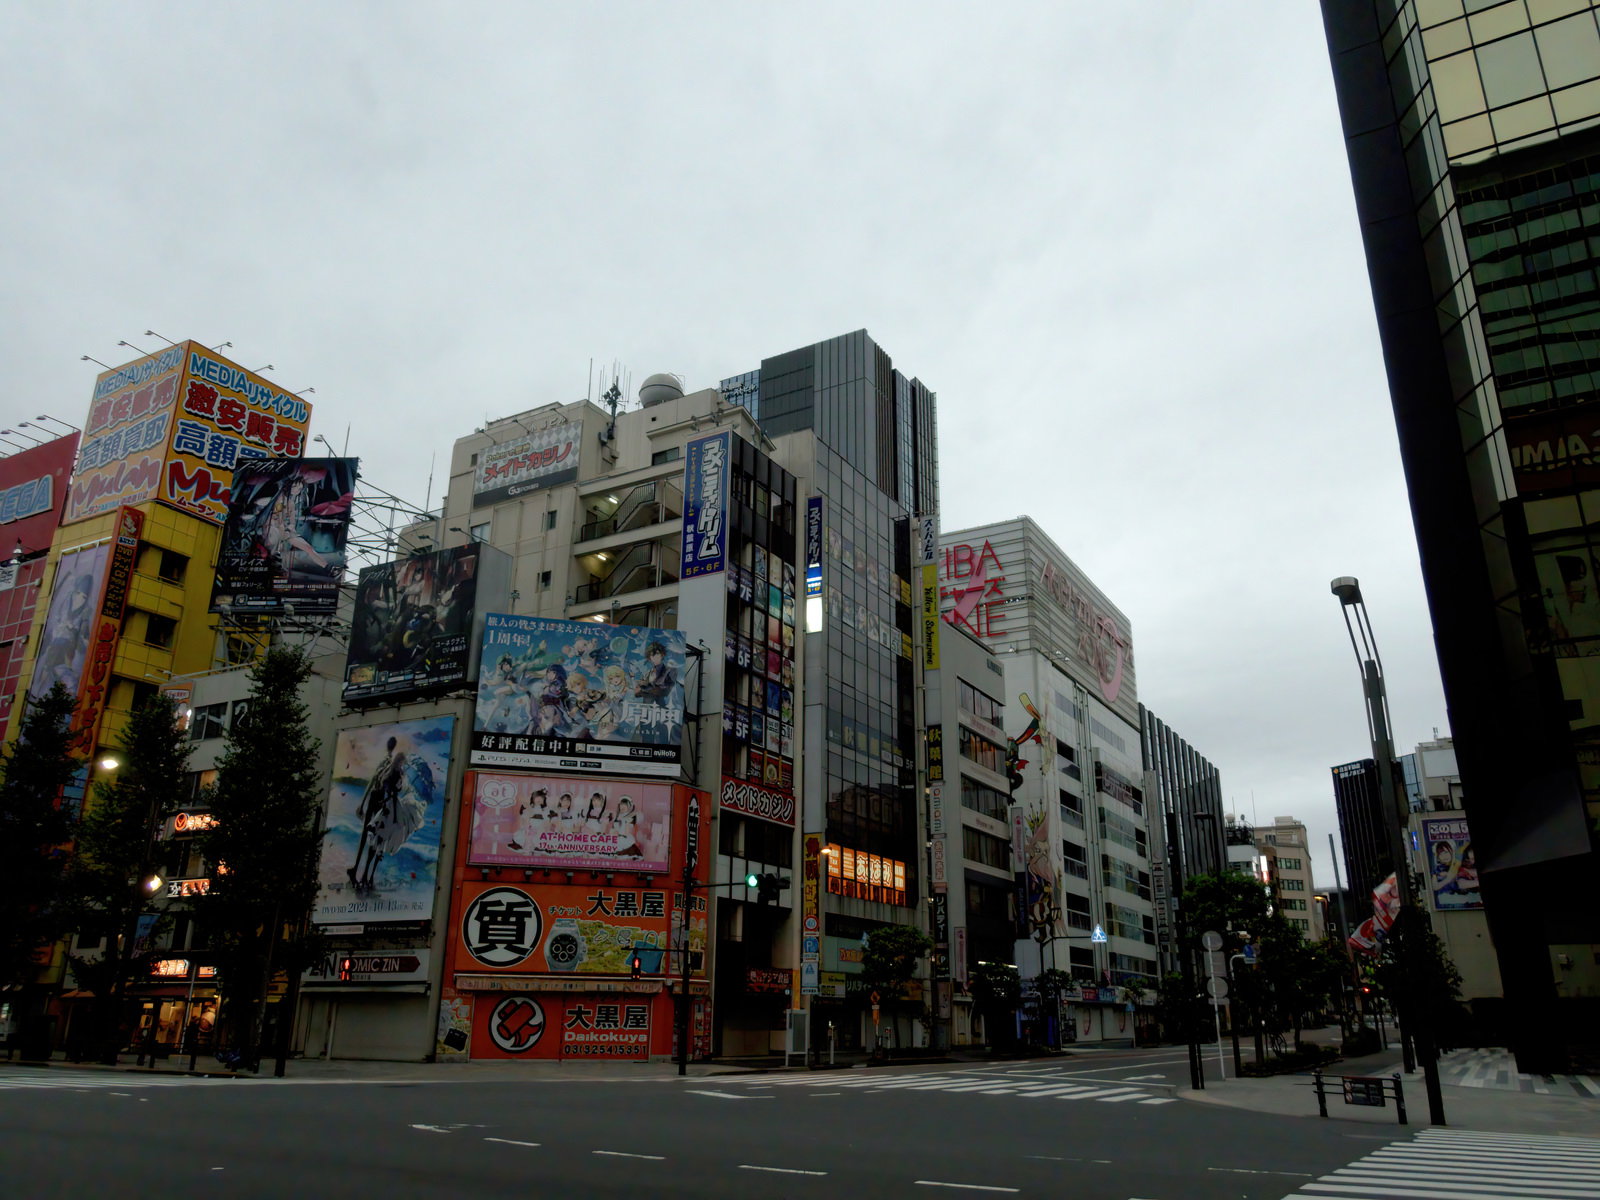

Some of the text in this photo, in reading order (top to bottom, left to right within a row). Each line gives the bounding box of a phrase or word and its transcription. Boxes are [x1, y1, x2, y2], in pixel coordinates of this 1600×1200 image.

[190, 352, 308, 423] MEDIAリサイクル
[183, 379, 304, 457] 激安販売
[483, 441, 572, 484] メイドカジノ
[0, 474, 53, 524] EGA
[942, 539, 1003, 580] IBA
[740, 585, 752, 602] 7F
[737, 650, 751, 668] 6F
[736, 722, 750, 739] 5F
[481, 735, 571, 754] 好評配信中!
[721, 780, 795, 822] メイドカジノ
[590, 835, 618, 845] CAFE
[548, 905, 582, 915] チケット
[587, 889, 665, 918] 大黒屋
[472, 899, 533, 957] 質
[382, 957, 401, 972] ZIN
[564, 1004, 648, 1030] 大黒屋
[565, 1031, 648, 1043] Daikokuya
[565, 1045, 647, 1055] 03(3254)5351
